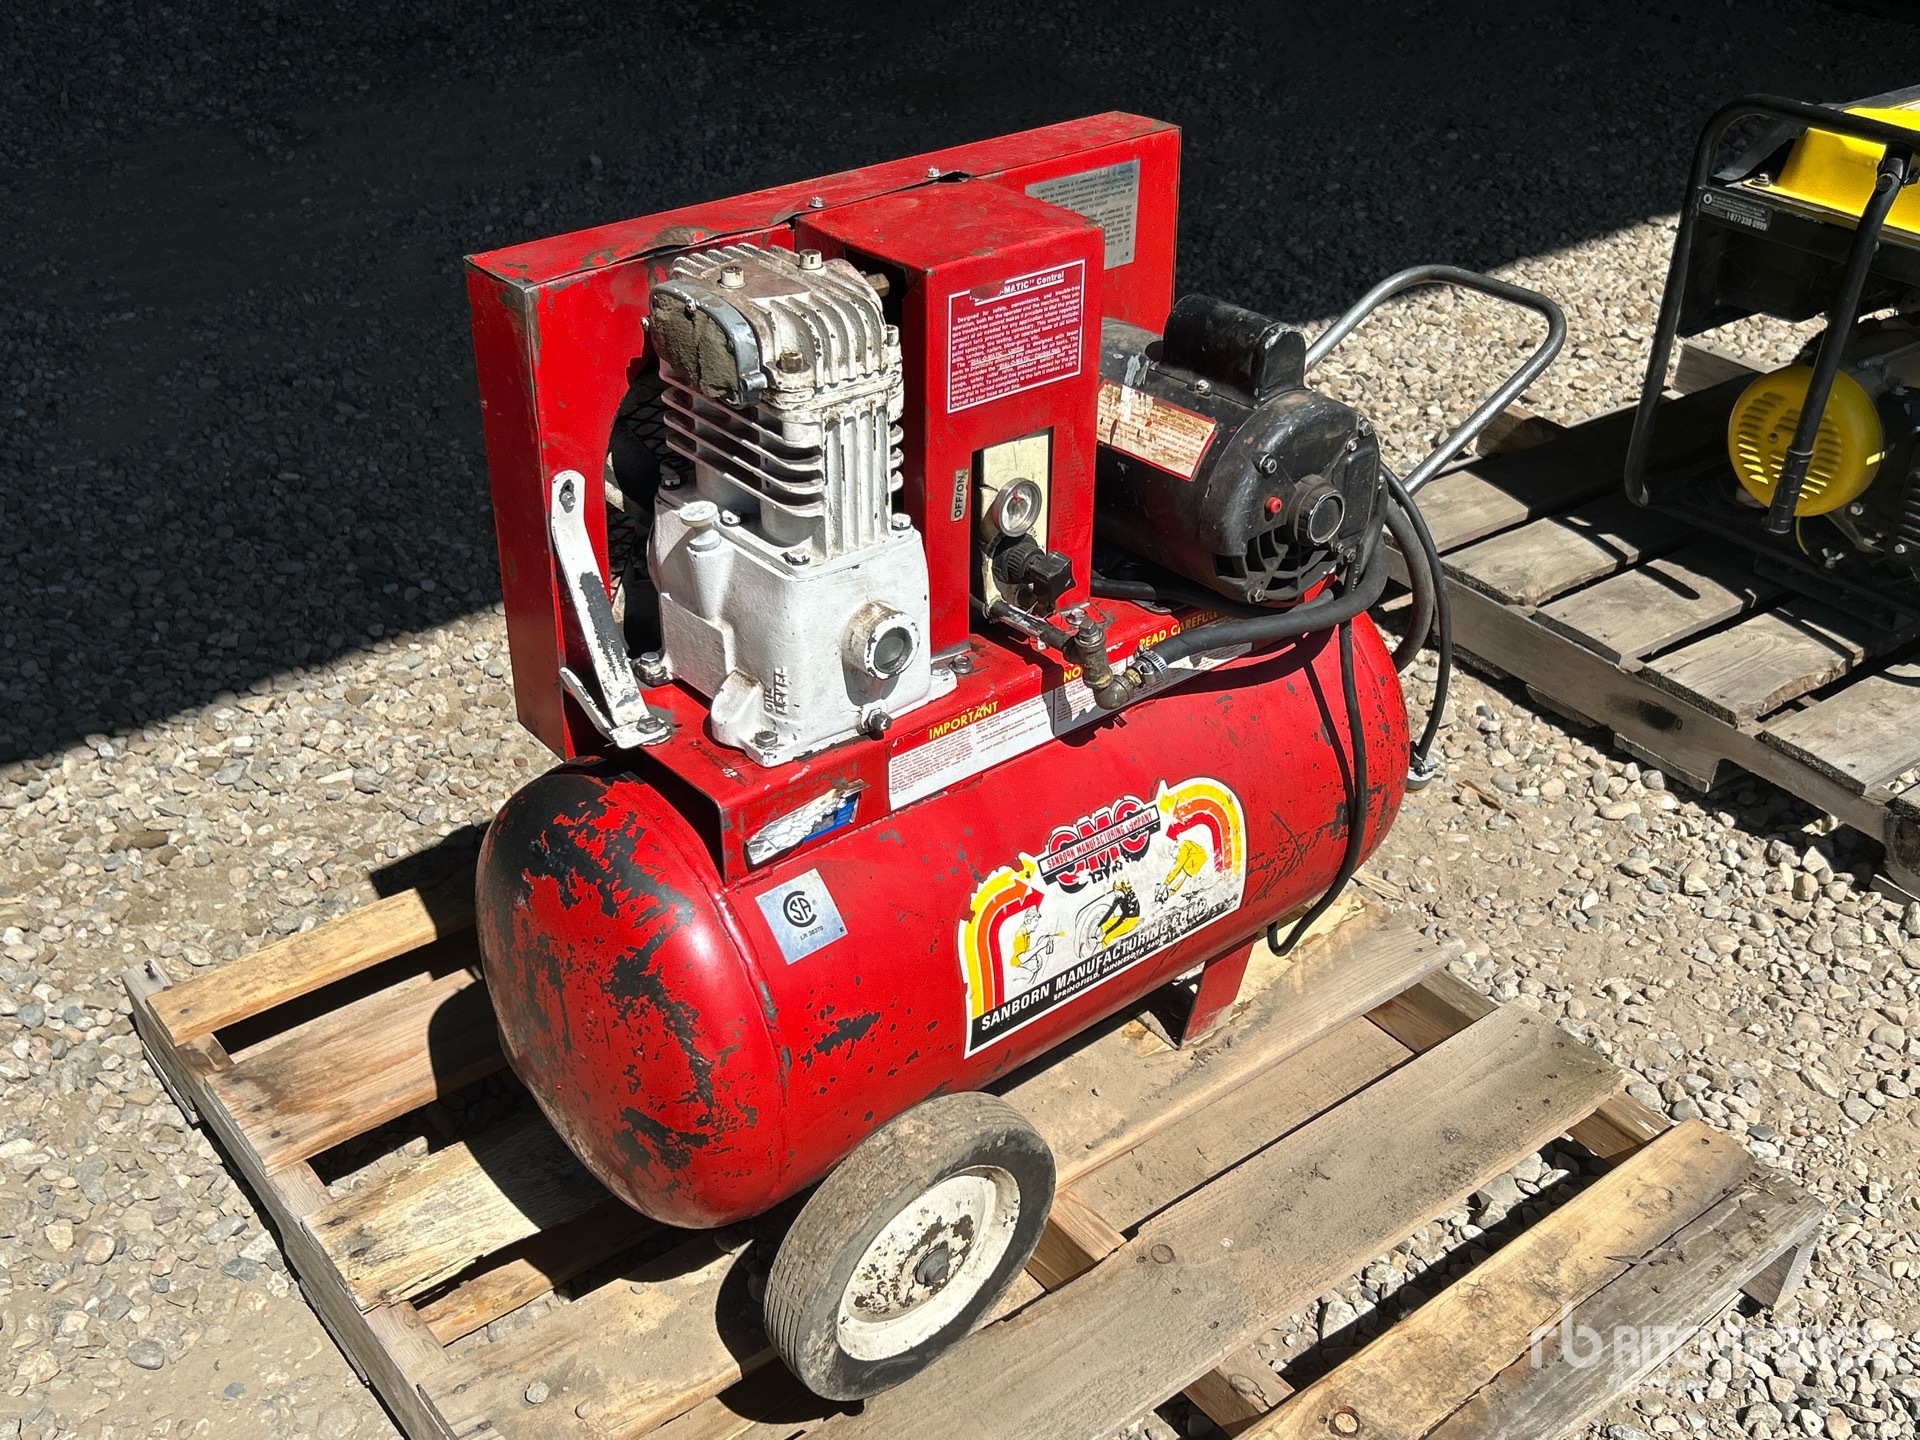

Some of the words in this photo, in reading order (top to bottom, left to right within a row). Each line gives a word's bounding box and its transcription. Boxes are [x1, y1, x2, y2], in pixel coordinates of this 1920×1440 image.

[1036, 270, 1064, 285] Control
[954, 475, 966, 519] OFF/ON
[1170, 611, 1218, 636] CAREFULL
[764, 688, 775, 712] OIL
[774, 666, 788, 716] LEVEL
[928, 701, 998, 740] IMPORTANT
[1046, 850, 1076, 869] SANBORN
[1076, 825, 1125, 857] MANUFACTURING
[1126, 811, 1153, 832] COMPANY
[783, 890, 817, 927] CSA
[799, 933, 808, 942] LR
[981, 983, 1050, 1031] SANBORN
[1055, 920, 1169, 992] MANUFACTURING
[1053, 971, 1100, 1001] SPRINGFIELD,
[1102, 947, 1145, 975] MINNESOTA
